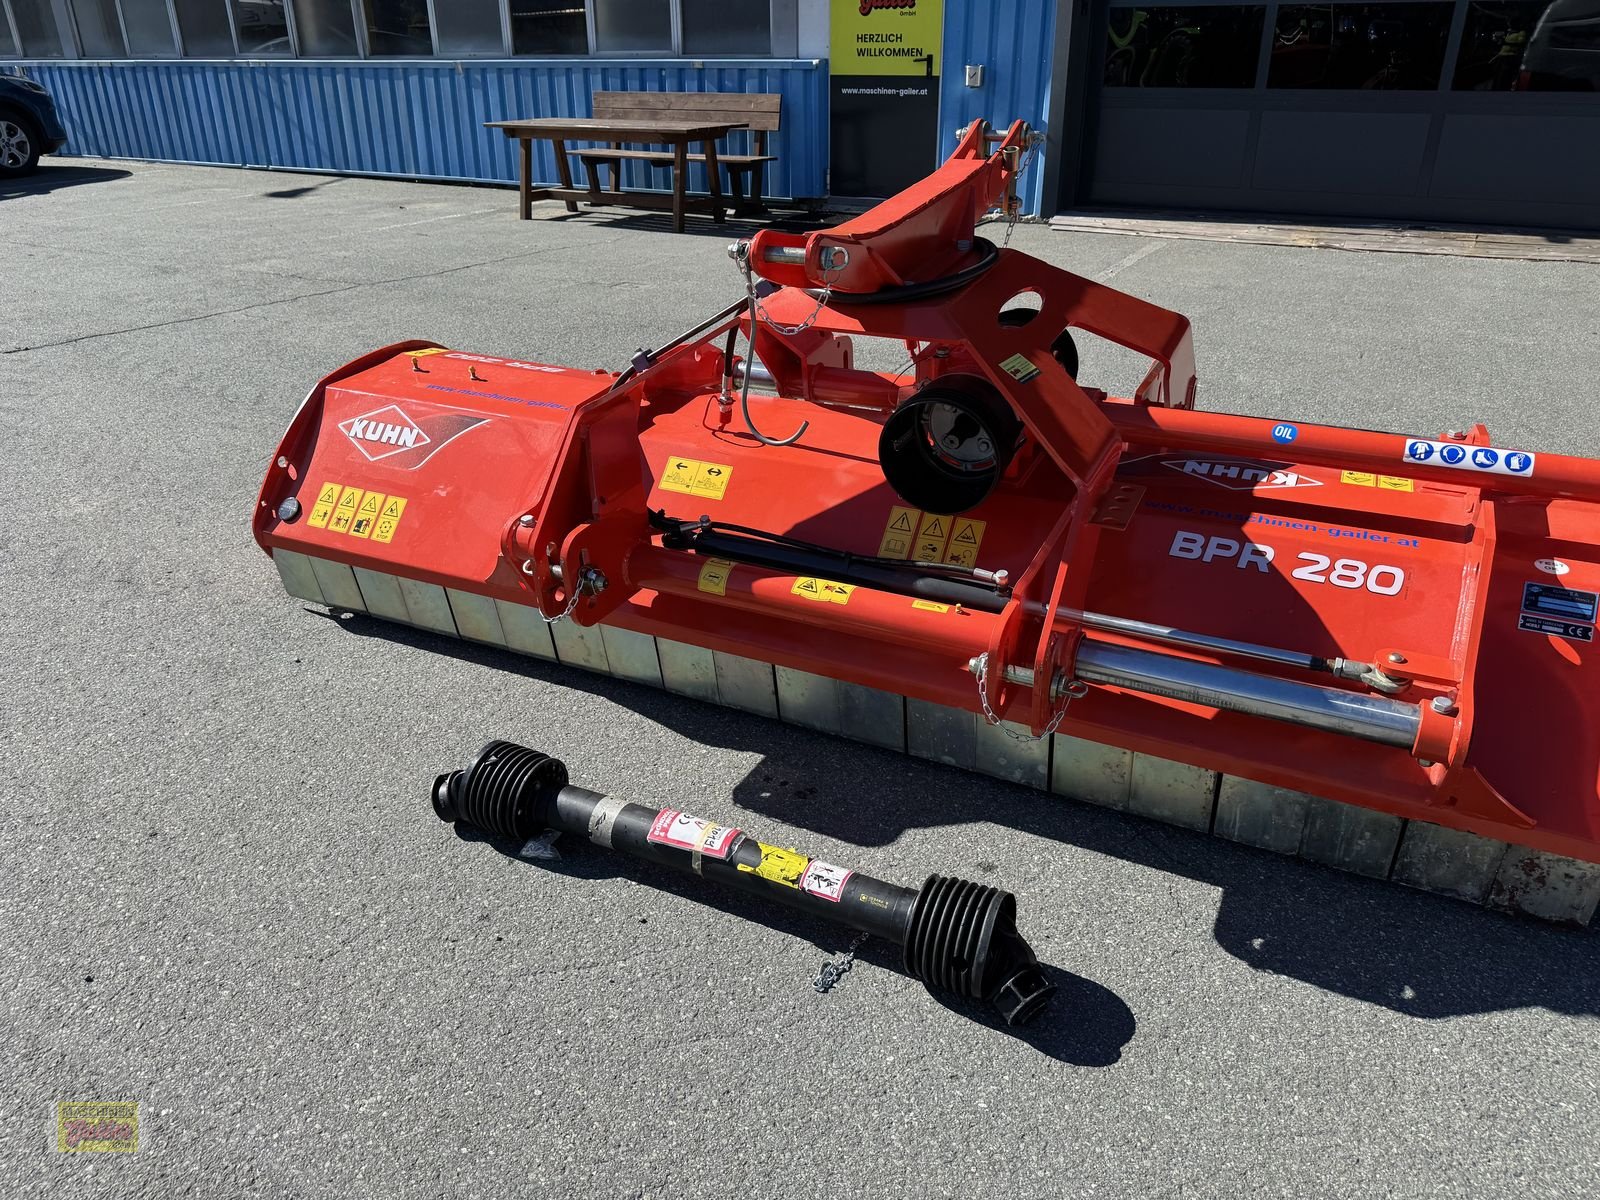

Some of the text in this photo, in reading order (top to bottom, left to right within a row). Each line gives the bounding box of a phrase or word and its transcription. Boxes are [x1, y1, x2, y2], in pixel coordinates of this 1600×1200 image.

[856, 33, 903, 43] HERZLICH
[856, 47, 923, 57] WILLKOMMEN
[841, 87, 928, 97] www.maschinen-gailer.at
[348, 418, 420, 449] KUHN
[1274, 425, 1294, 441] OIL
[1181, 459, 1300, 488] KUHN
[1144, 500, 1421, 549] www.maschinen-gailer.at
[1168, 530, 1276, 574] BPR
[1290, 551, 1406, 597] 280
